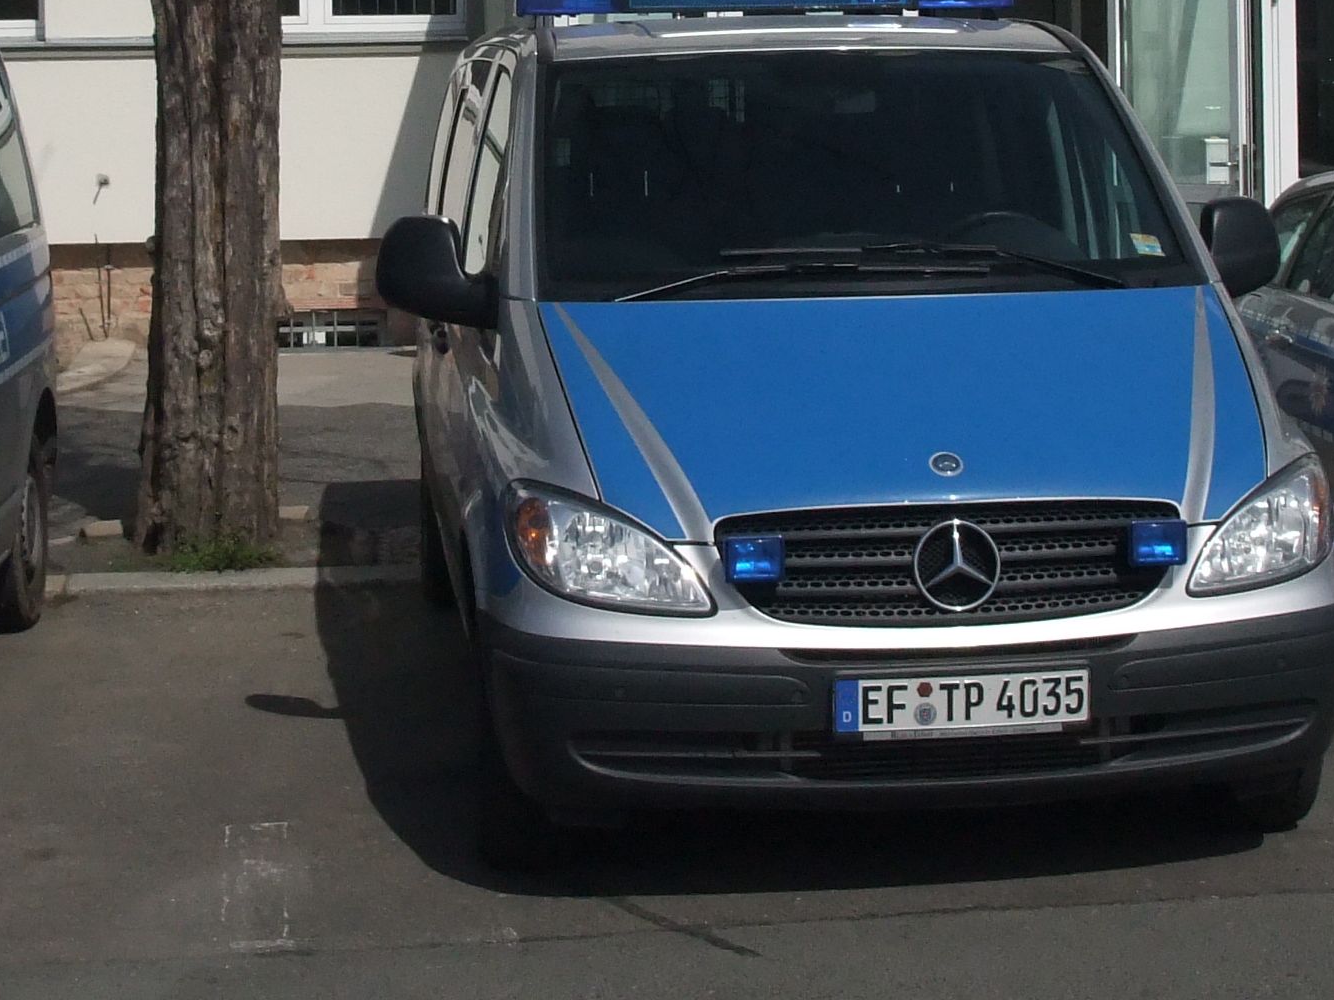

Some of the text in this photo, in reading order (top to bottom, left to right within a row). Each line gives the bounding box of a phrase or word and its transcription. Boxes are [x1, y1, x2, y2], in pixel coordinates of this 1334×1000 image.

[862, 675, 1085, 725] EF TP 4035
